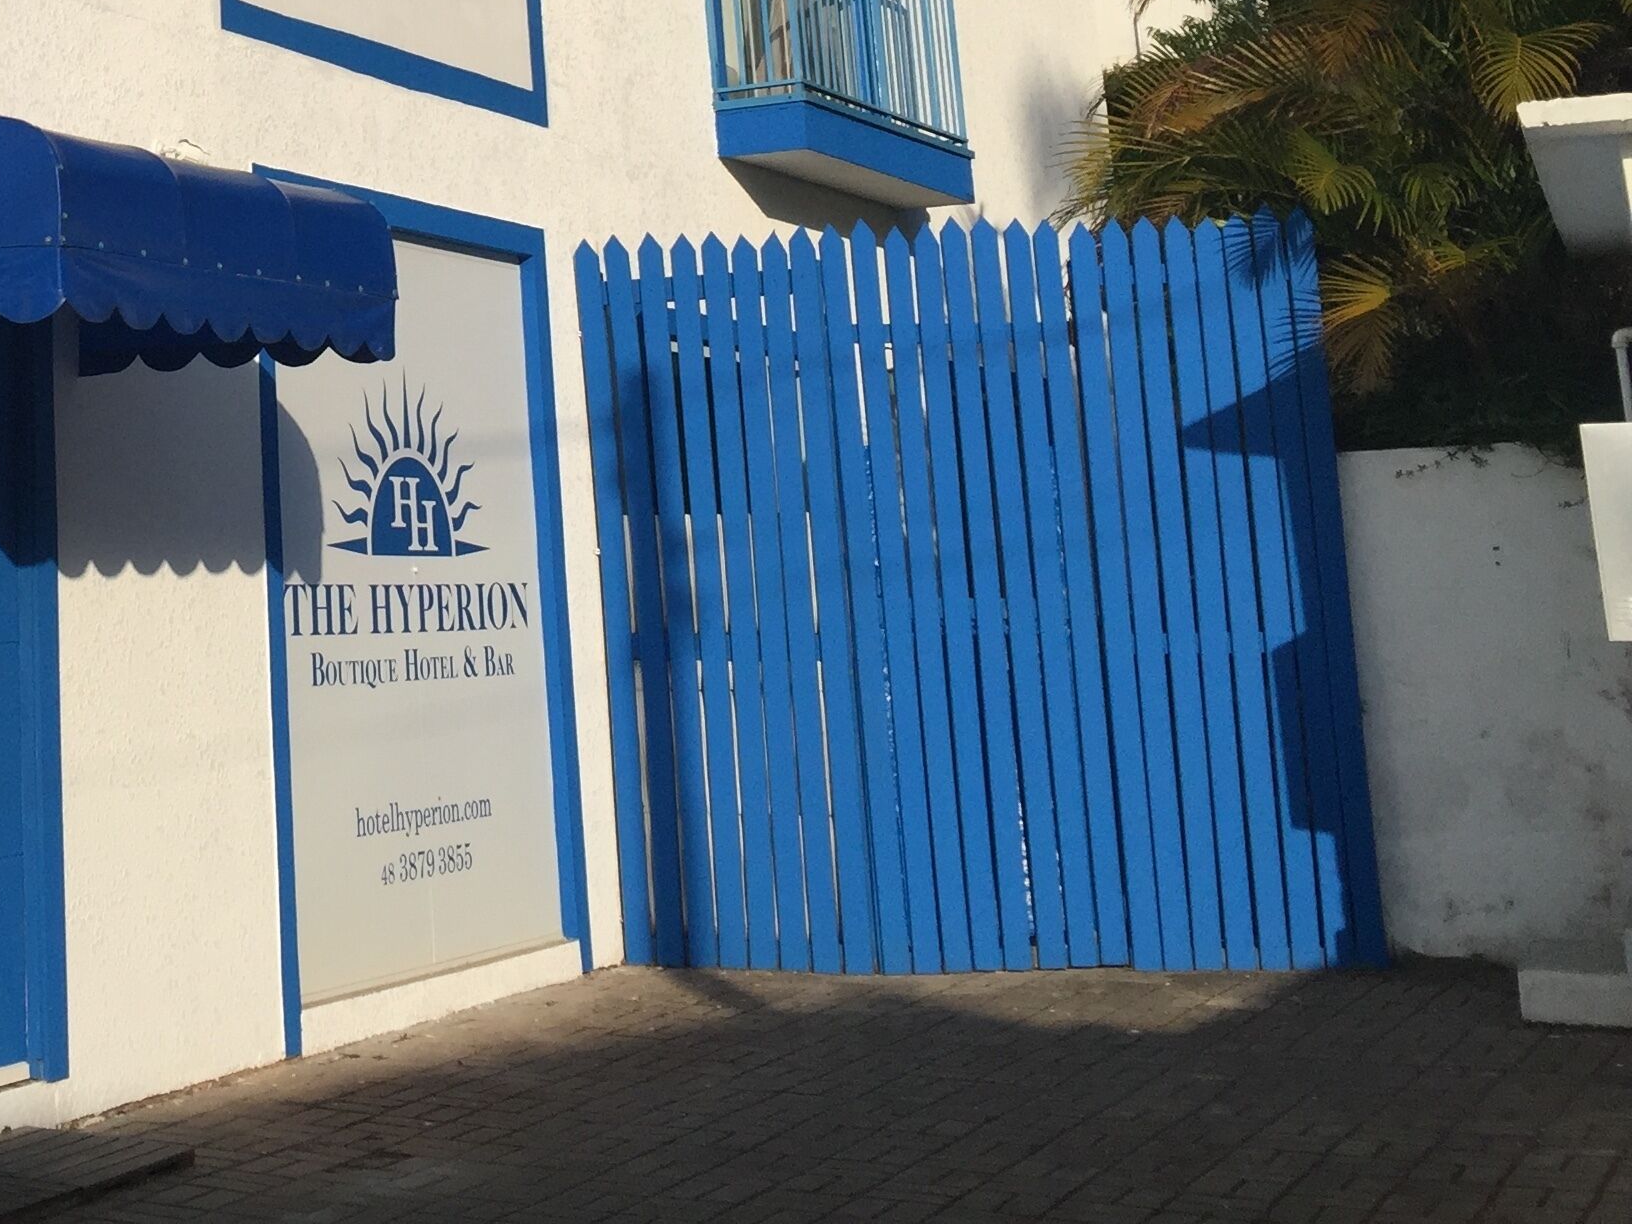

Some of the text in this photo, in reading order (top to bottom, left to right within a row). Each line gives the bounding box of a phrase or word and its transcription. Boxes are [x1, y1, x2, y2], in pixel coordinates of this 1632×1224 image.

[284, 582, 529, 636] THE HYPERION
[463, 645, 479, 678] &
[355, 796, 492, 837] hotelhyperion.com
[381, 842, 473, 885] 48 3879 3855
